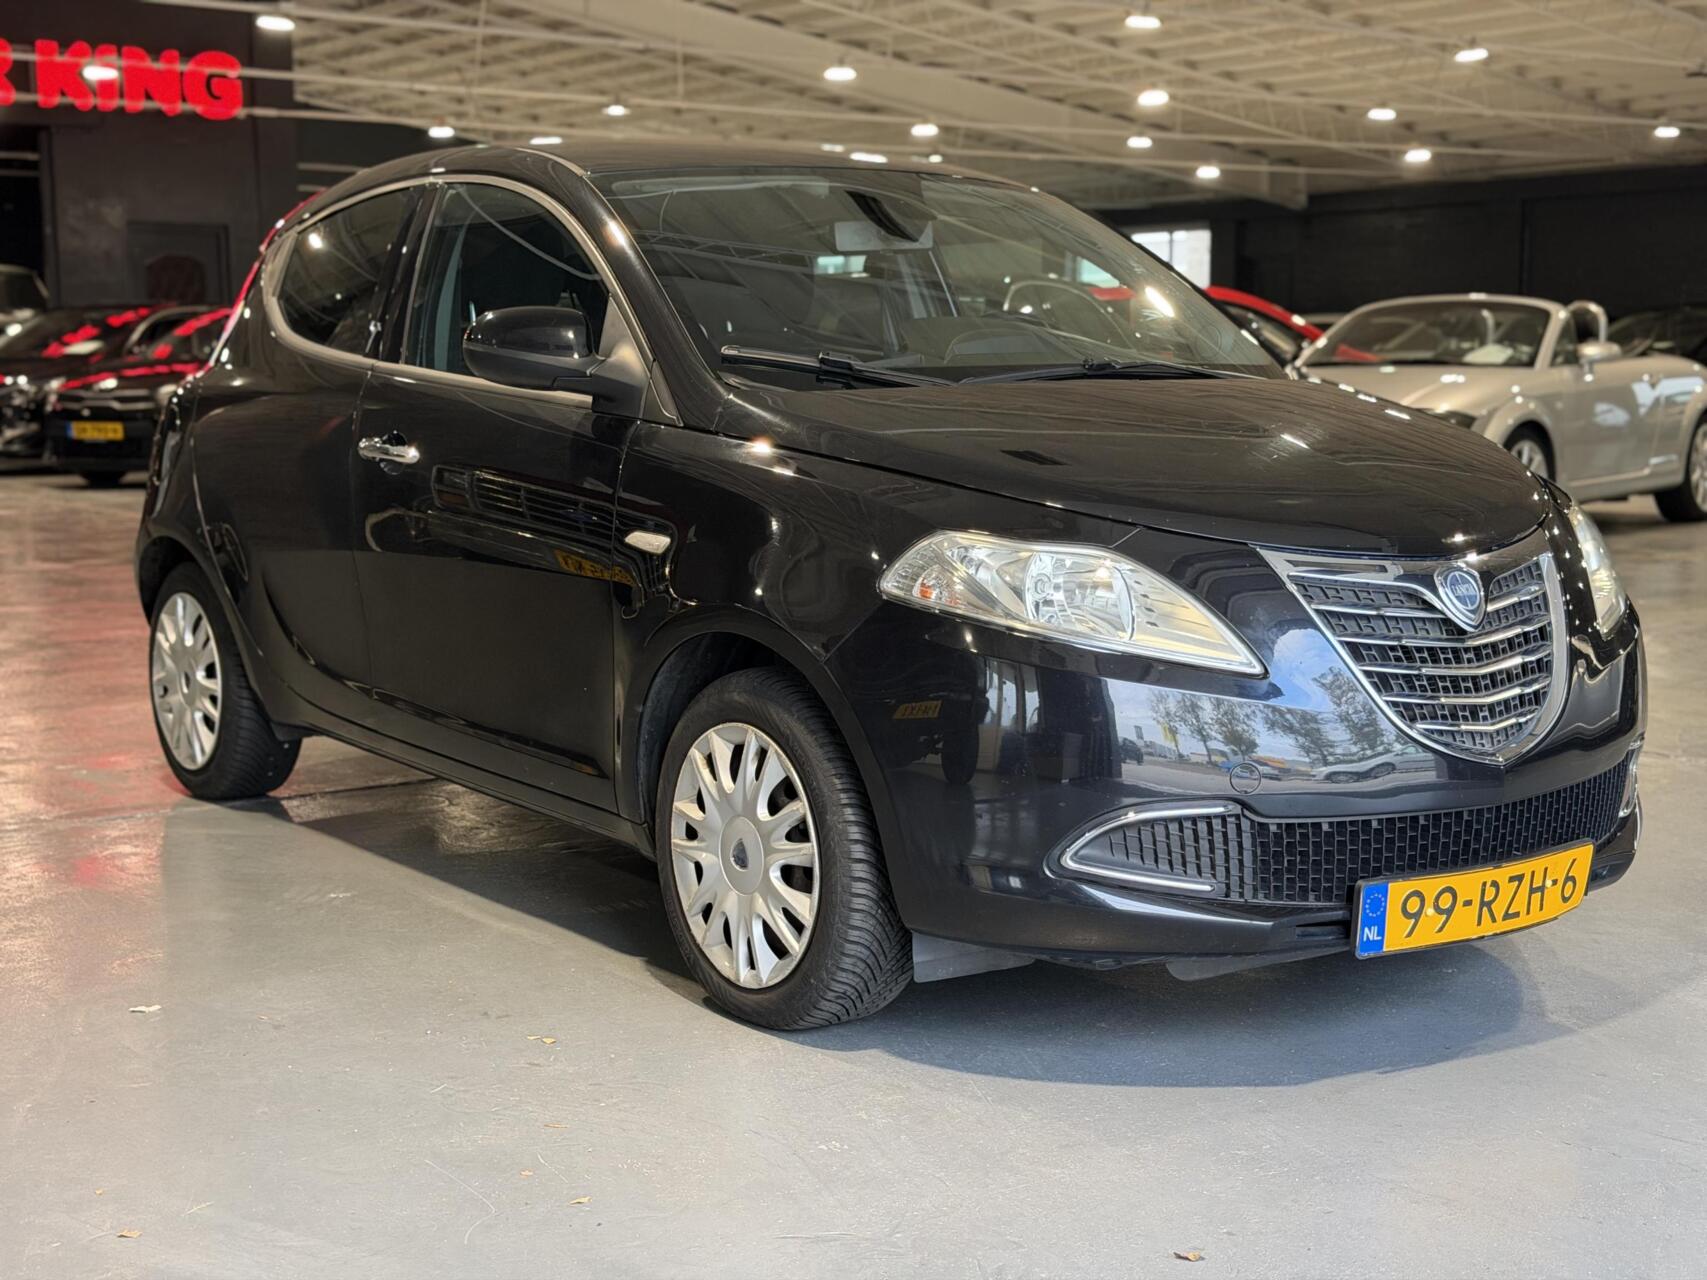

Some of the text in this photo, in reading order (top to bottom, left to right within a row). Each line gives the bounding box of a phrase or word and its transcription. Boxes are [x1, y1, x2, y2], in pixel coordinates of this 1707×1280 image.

[35, 39, 244, 121] KING
[1363, 925, 1382, 941] NL
[1400, 857, 1577, 938] 99-RZH-6
